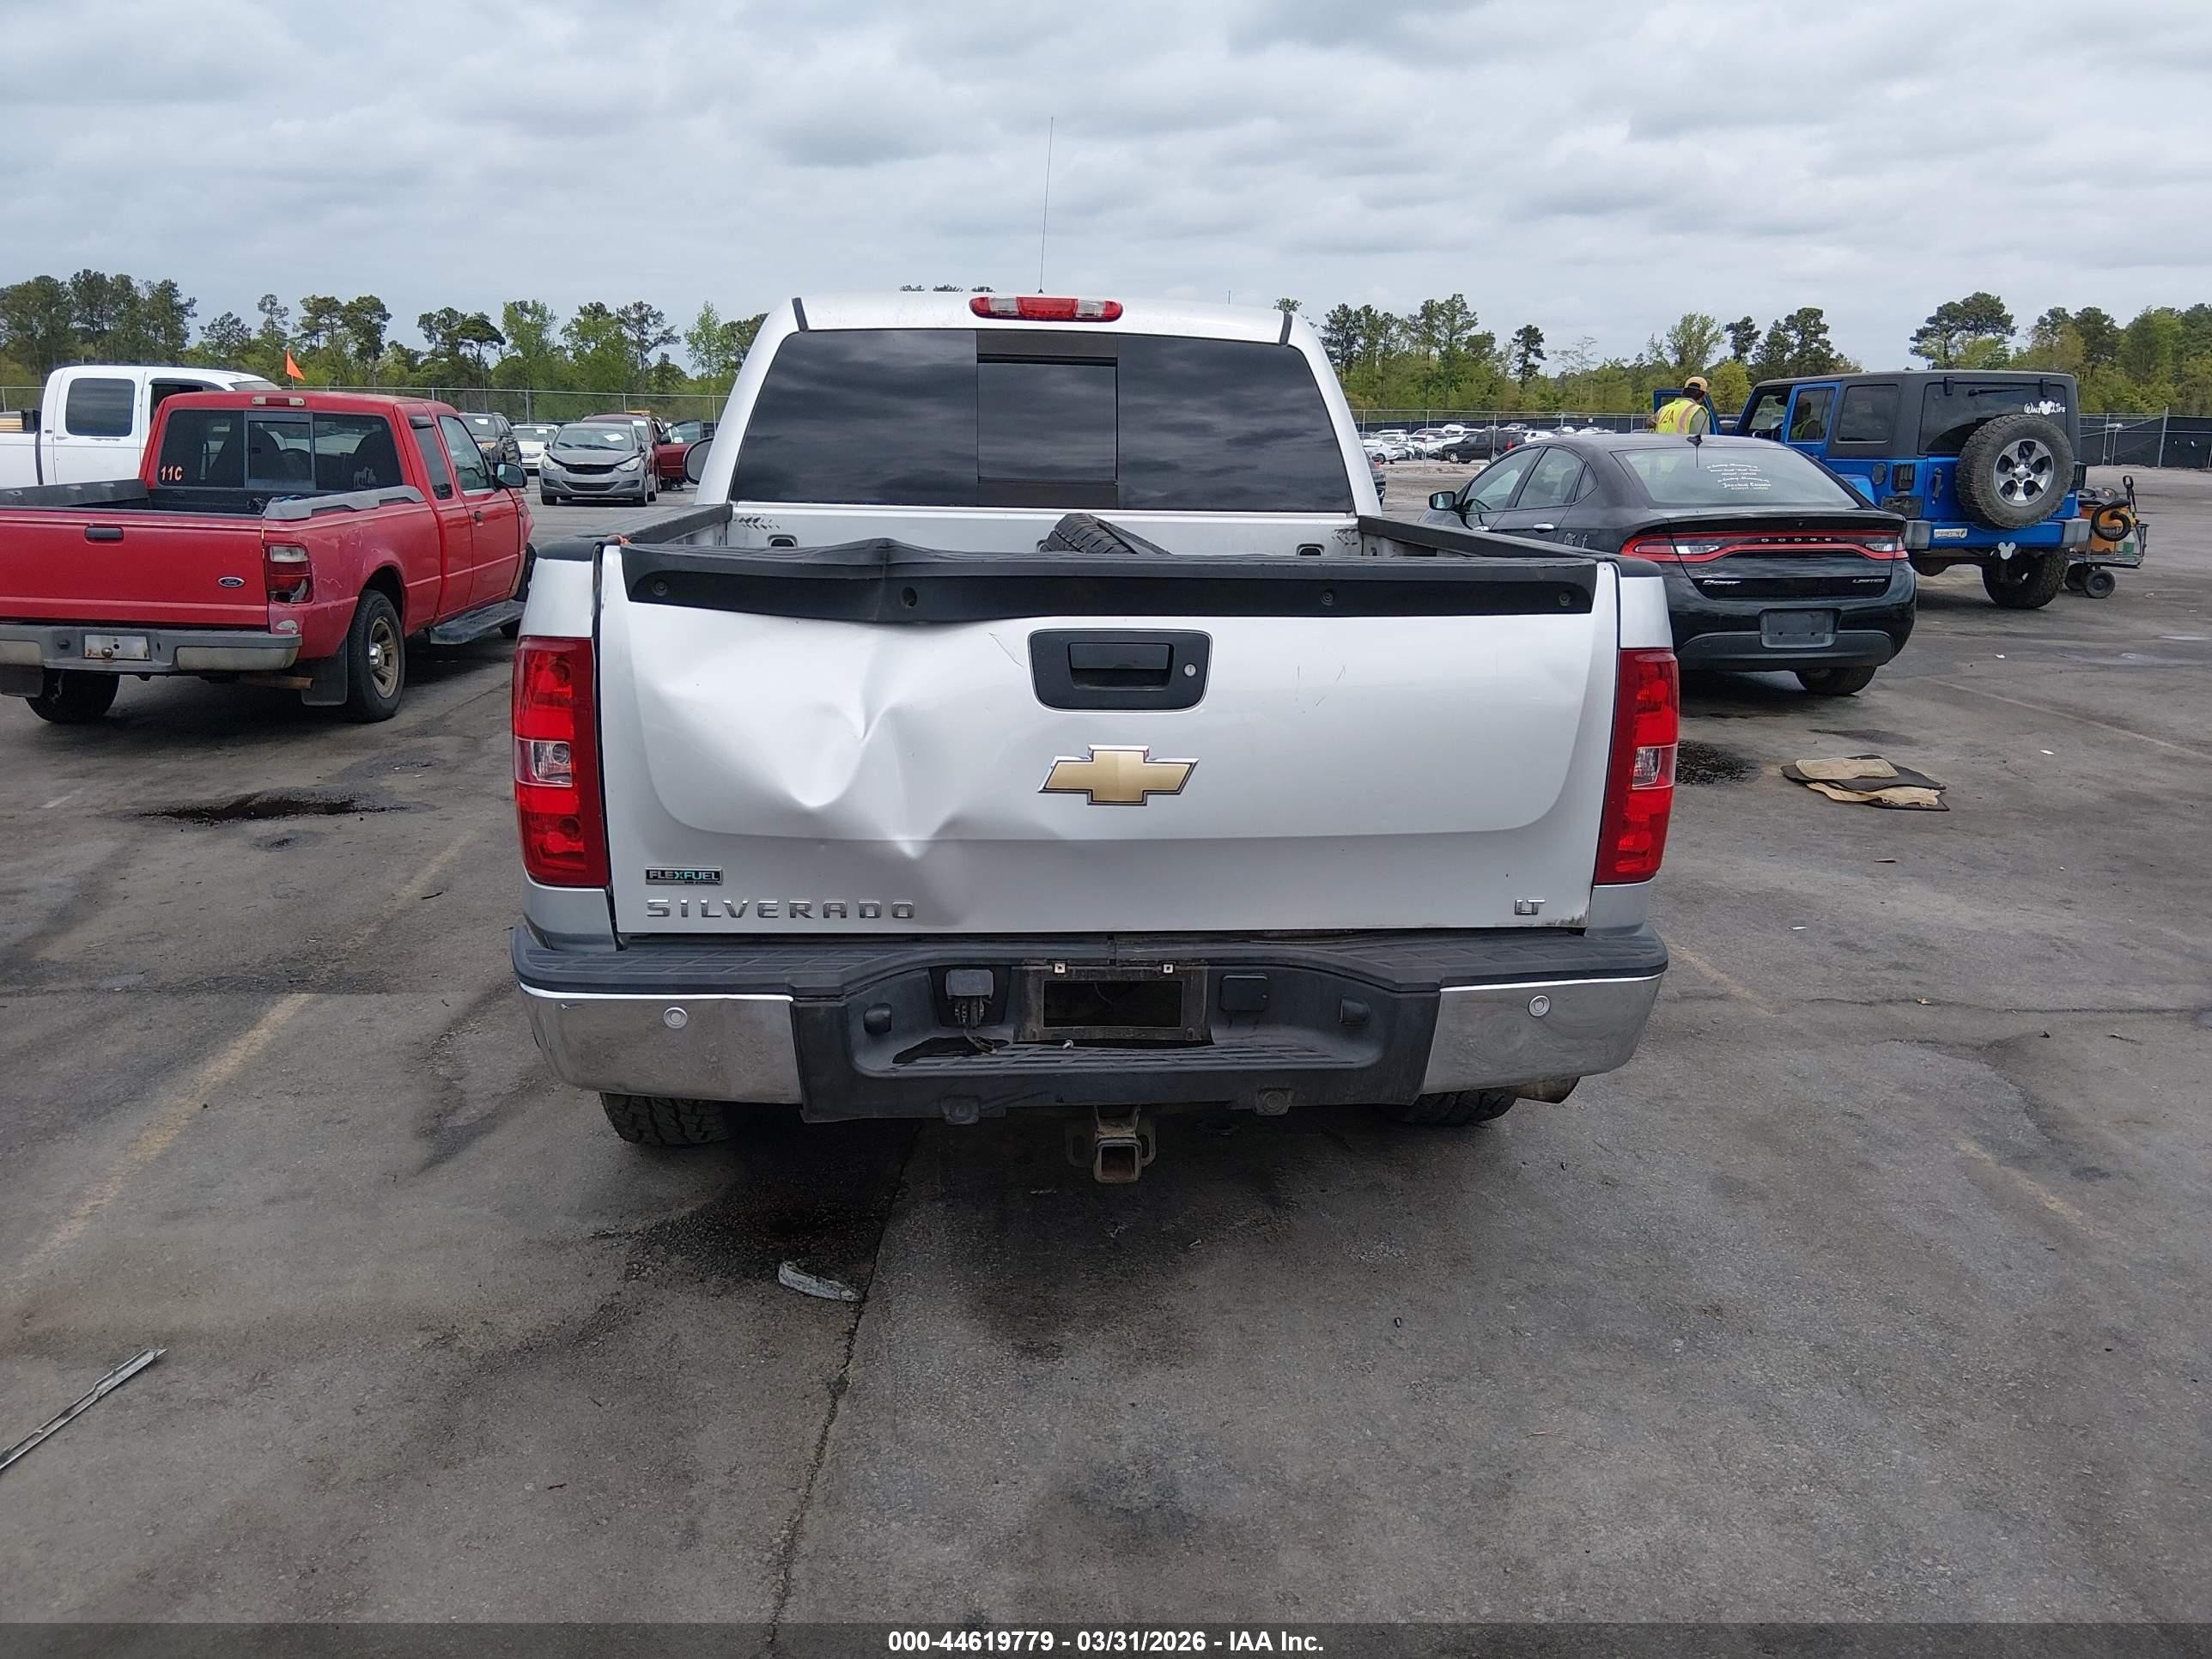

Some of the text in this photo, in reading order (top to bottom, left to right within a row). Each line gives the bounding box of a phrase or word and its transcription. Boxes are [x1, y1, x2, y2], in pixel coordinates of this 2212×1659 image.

[161, 465, 183, 481] 11C
[648, 870, 720, 880] FLEXFUEL
[647, 899, 915, 919] SILVERADO
[1514, 899, 1546, 915] LT
